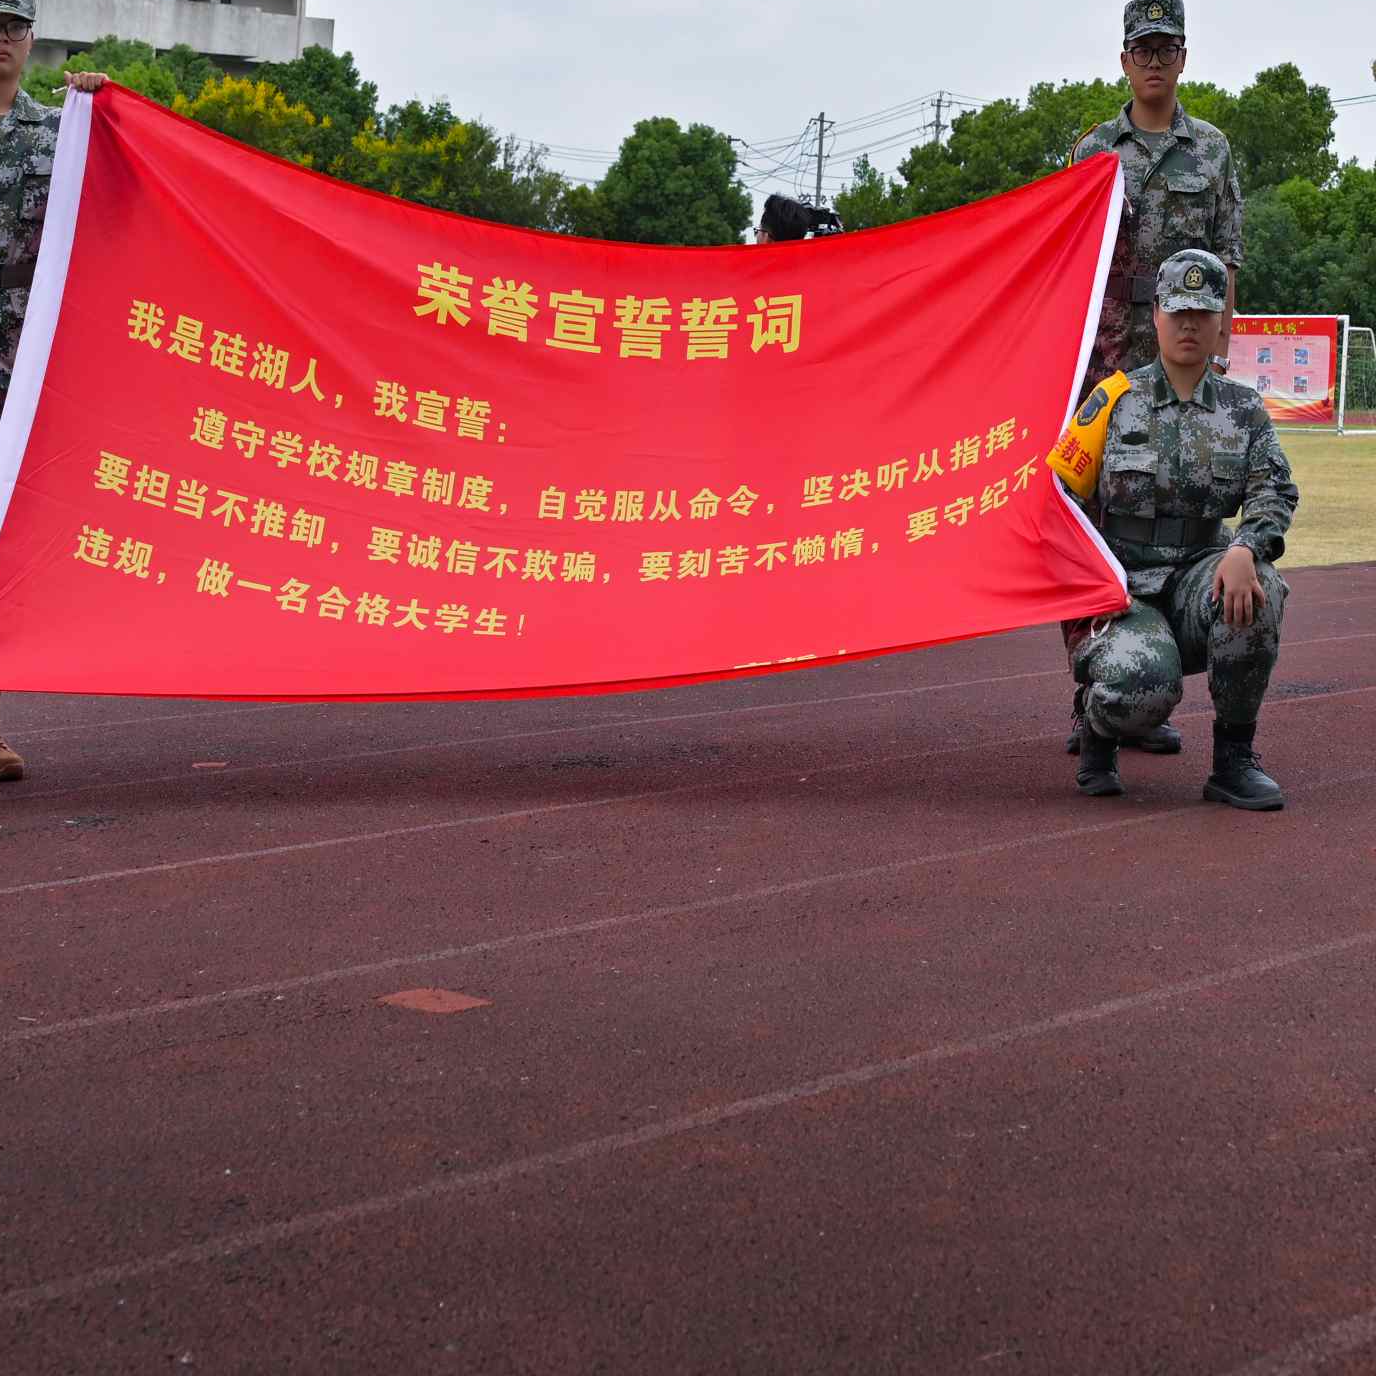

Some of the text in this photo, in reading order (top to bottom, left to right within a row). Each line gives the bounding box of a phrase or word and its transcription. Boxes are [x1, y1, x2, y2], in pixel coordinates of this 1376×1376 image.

[414, 262, 802, 361] 荣誉宣誓誓词
